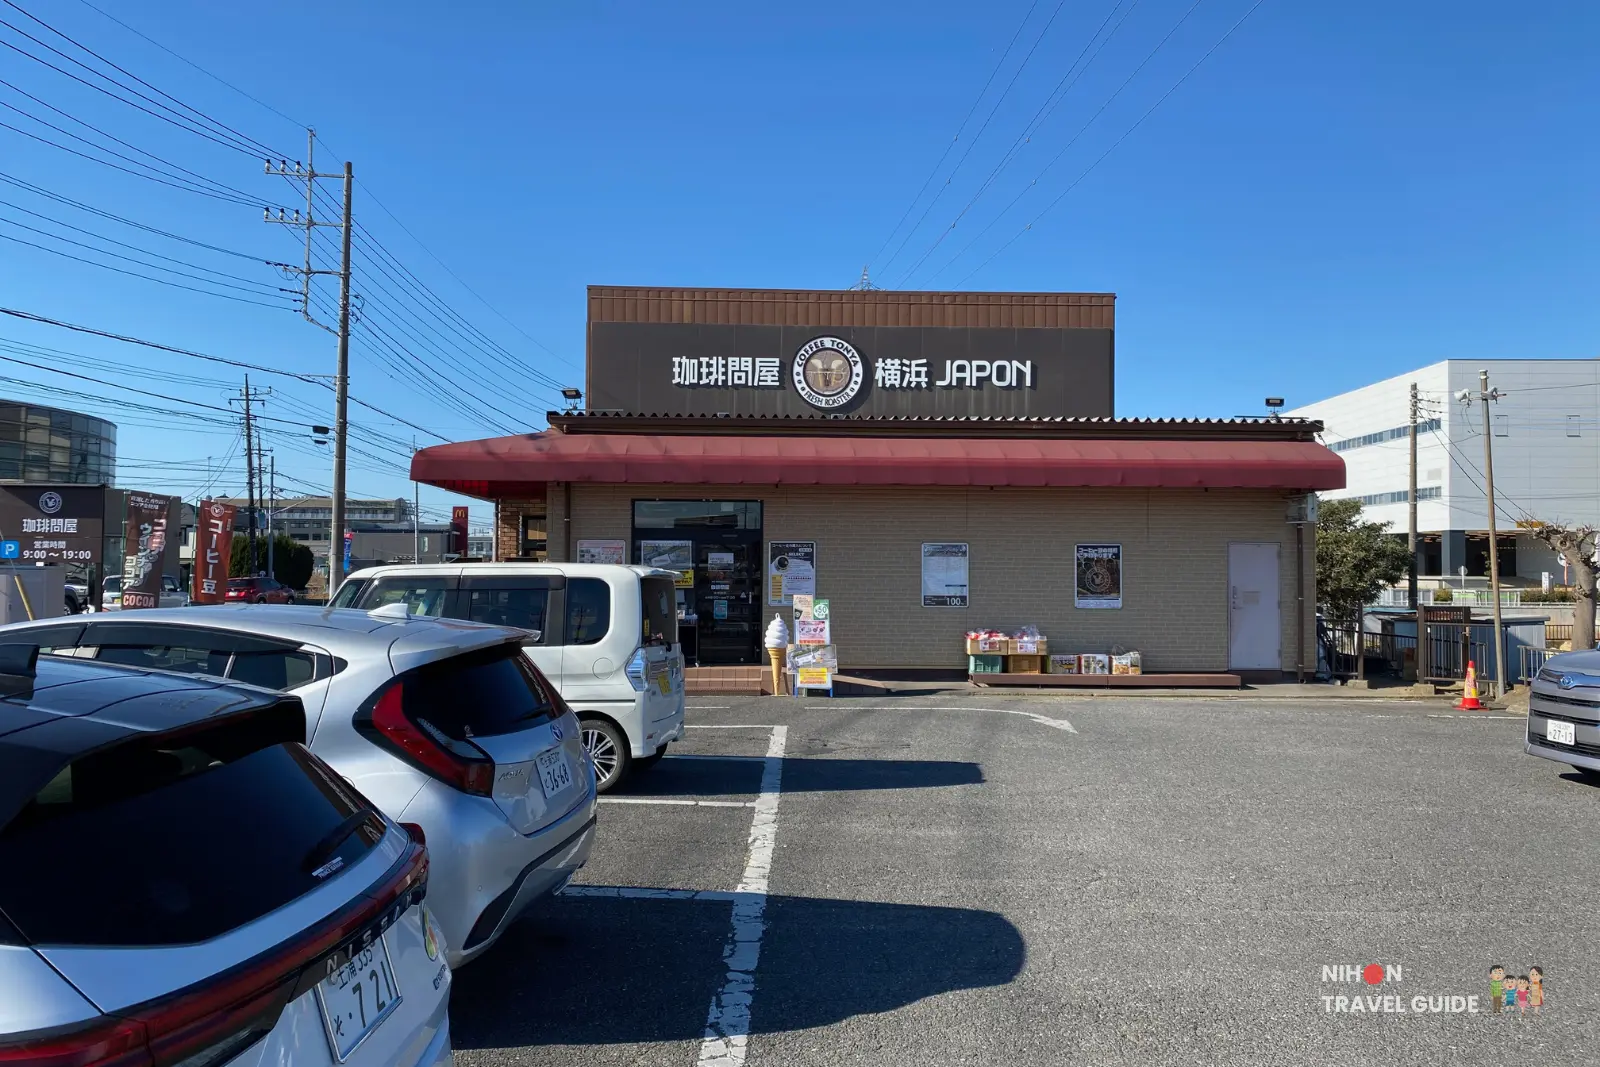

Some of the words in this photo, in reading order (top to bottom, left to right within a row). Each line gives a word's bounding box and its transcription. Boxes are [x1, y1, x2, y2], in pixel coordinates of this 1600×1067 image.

[796, 339, 826, 367] COFFEE
[830, 339, 859, 367] TONYA
[672, 356, 780, 387] 珈琲問屋
[875, 357, 929, 388] 横浜
[936, 359, 1031, 387] JAPON
[803, 390, 824, 406] FRESH
[824, 391, 852, 407] ROASTER
[22, 518, 78, 533] 珈琲問屋
[5, 543, 15, 556] P
[33, 540, 67, 549] 営業時間
[201, 519, 224, 595] コーヒー豆
[123, 594, 155, 608] COCOA
